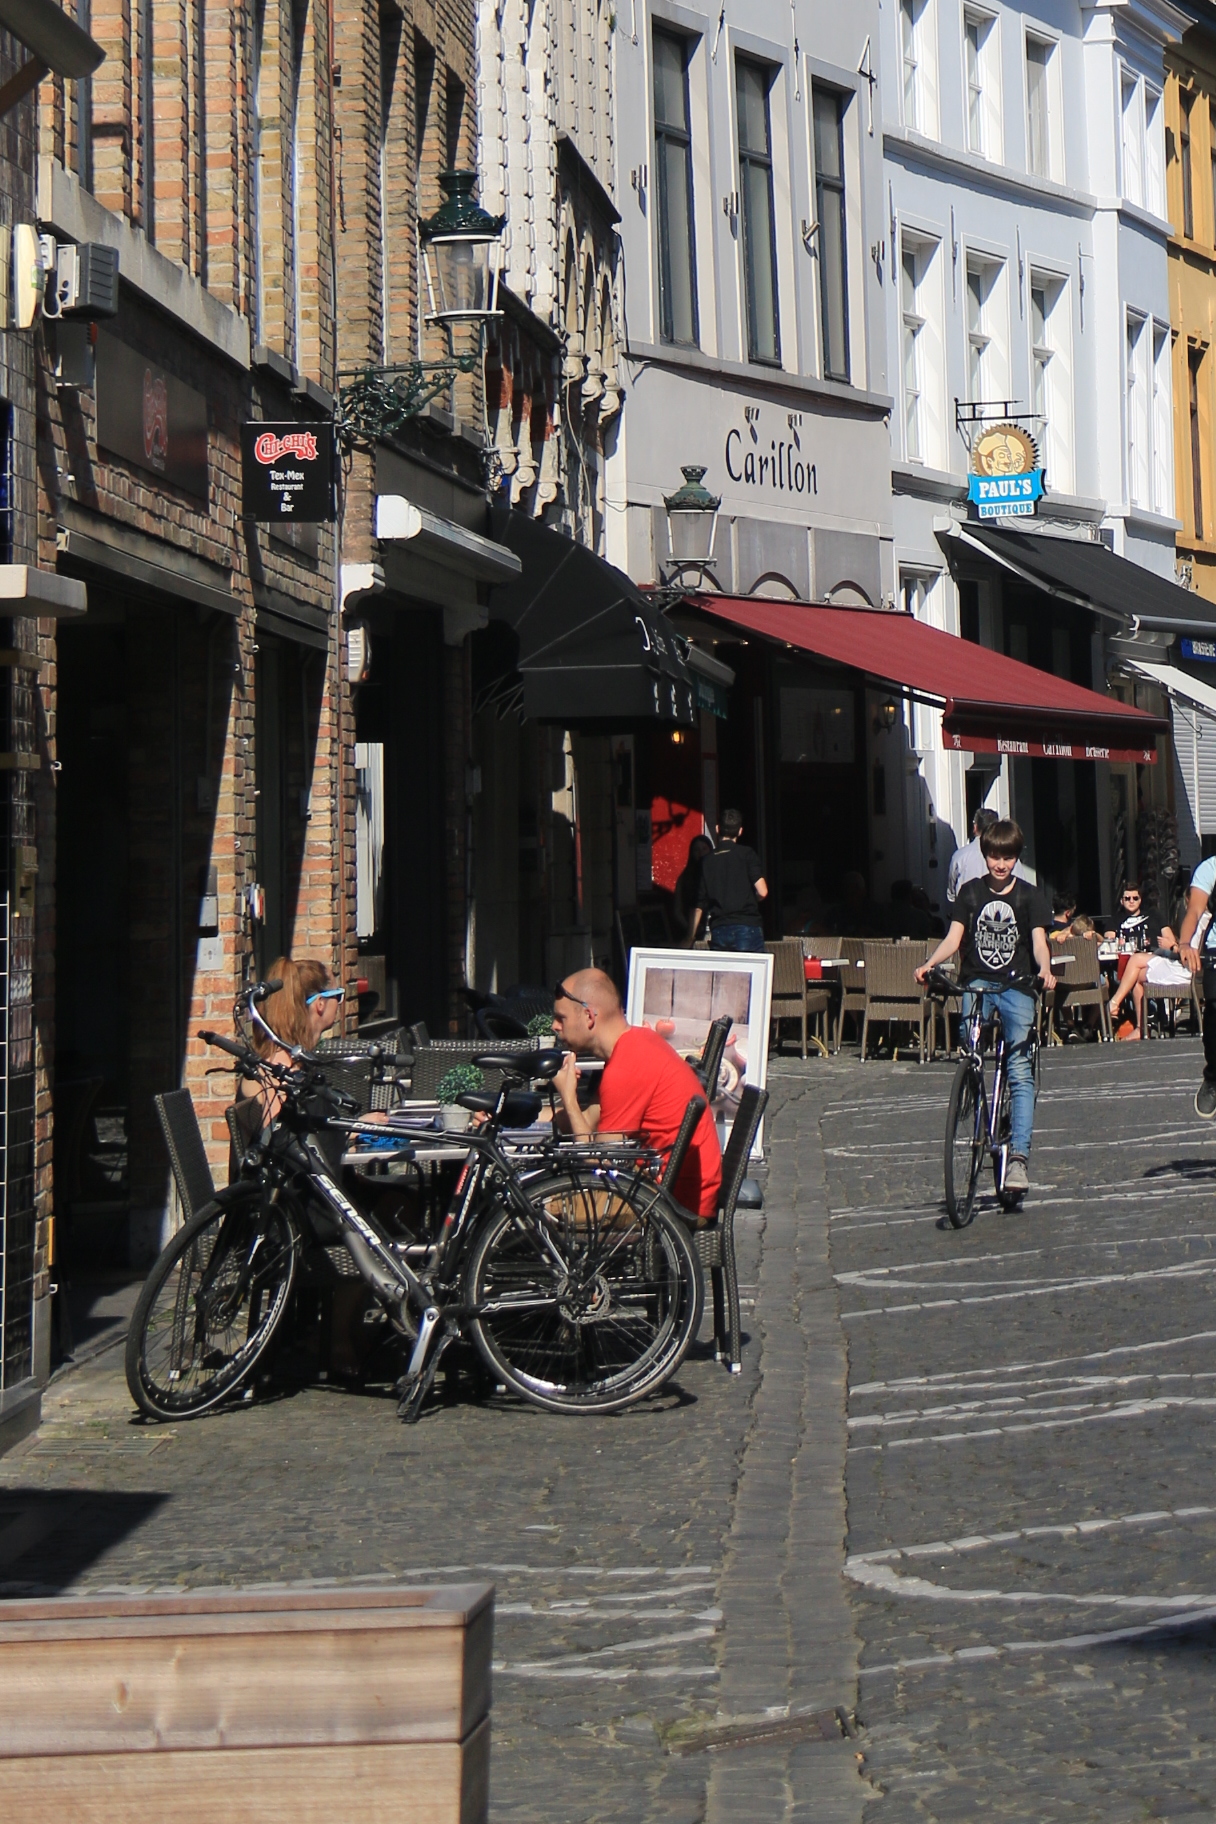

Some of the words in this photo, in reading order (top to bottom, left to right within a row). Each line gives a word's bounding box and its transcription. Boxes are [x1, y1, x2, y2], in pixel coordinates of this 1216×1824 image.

[254, 431, 318, 464] CHI-CHI'S
[725, 428, 818, 495] Carillon
[269, 470, 305, 480] Tex-Mex
[270, 482, 304, 491] Restaurant
[979, 478, 1033, 498] PAUL'S
[283, 491, 292, 501] &
[280, 503, 295, 512] Bar
[980, 503, 1033, 517] BOUTIQUE
[996, 733, 1029, 754] Restaurant
[1042, 733, 1073, 757] Carillon
